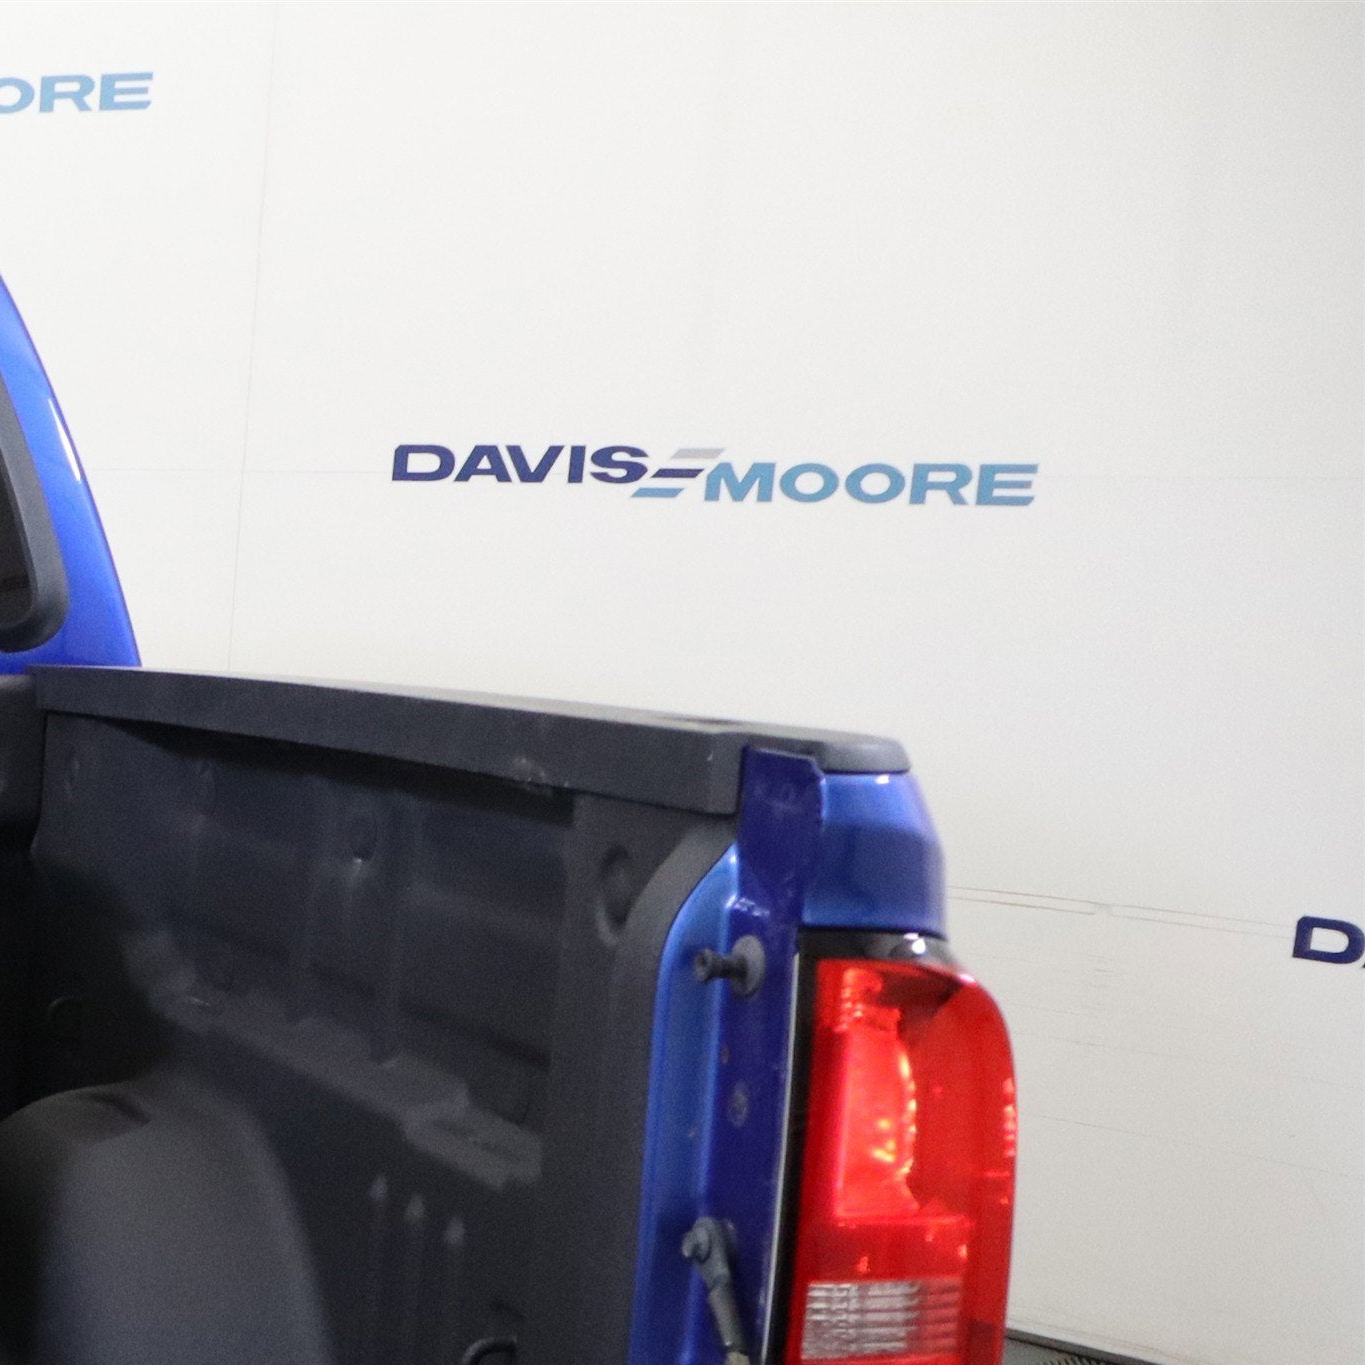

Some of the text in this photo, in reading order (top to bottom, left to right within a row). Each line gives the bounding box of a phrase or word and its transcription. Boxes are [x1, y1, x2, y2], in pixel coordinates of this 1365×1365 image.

[391, 443, 1040, 507] DAVIS MOORE
[1291, 914, 1365, 969] D
